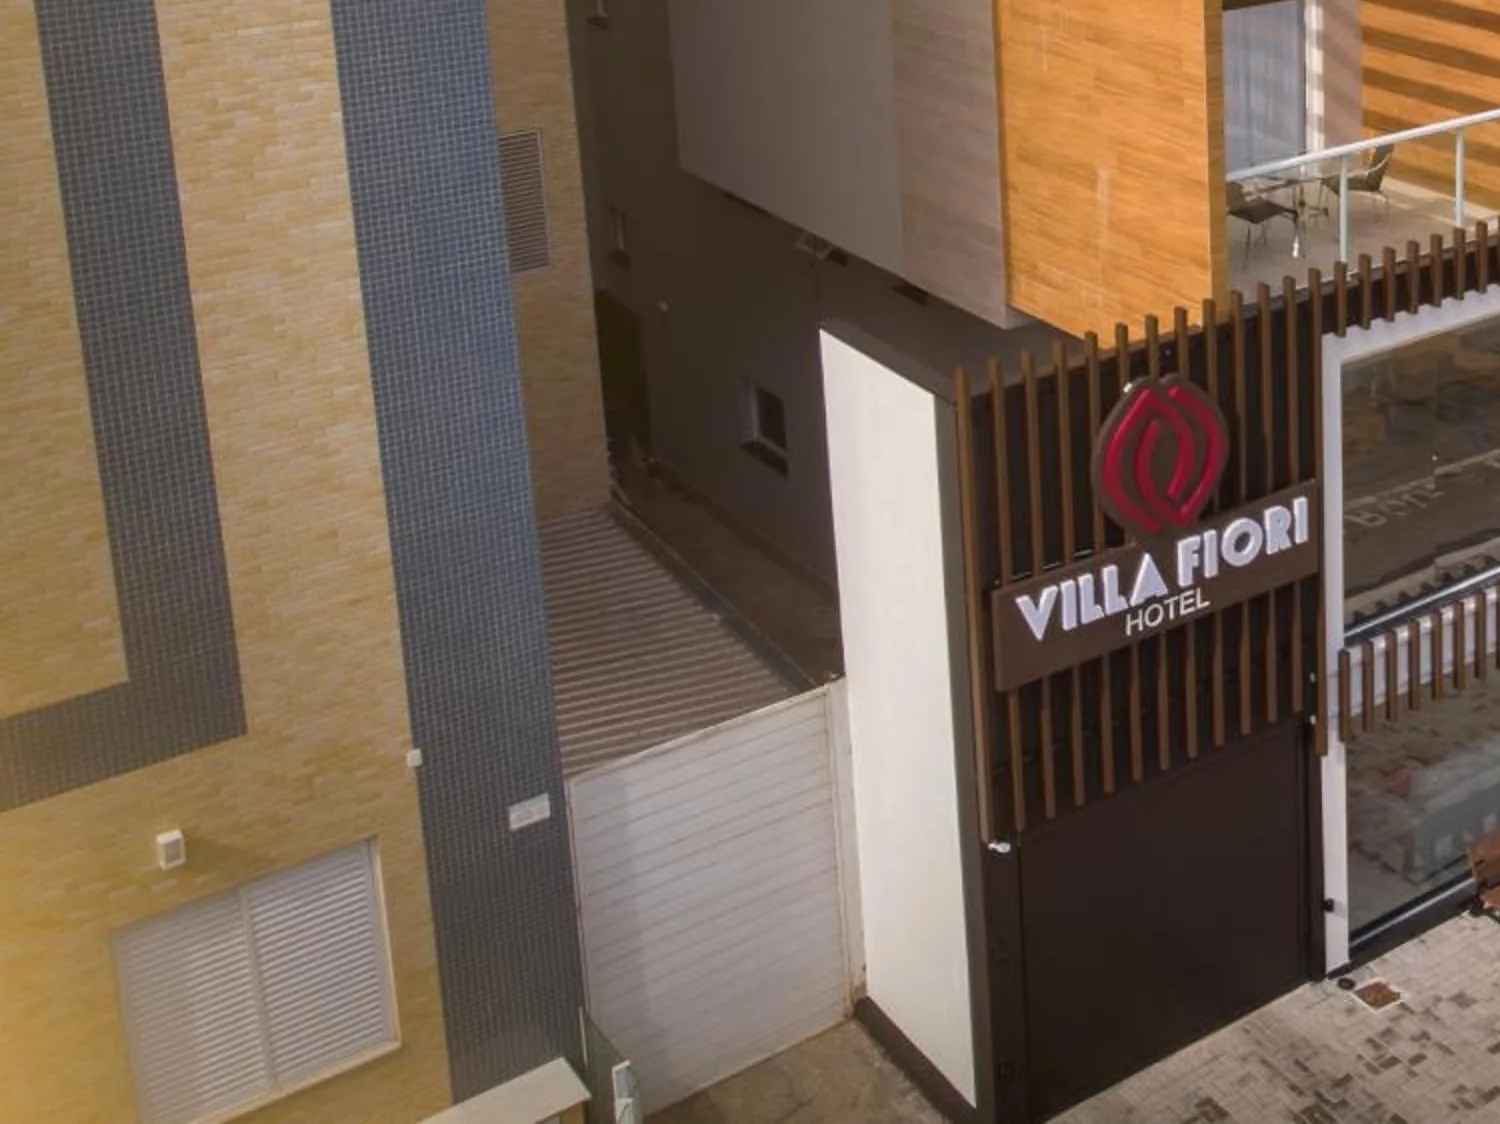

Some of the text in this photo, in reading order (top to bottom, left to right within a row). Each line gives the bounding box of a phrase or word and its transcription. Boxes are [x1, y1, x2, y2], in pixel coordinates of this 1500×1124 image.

[1015, 496, 1309, 641] VILLA FIORI
[1125, 587, 1211, 636] HOTEL
